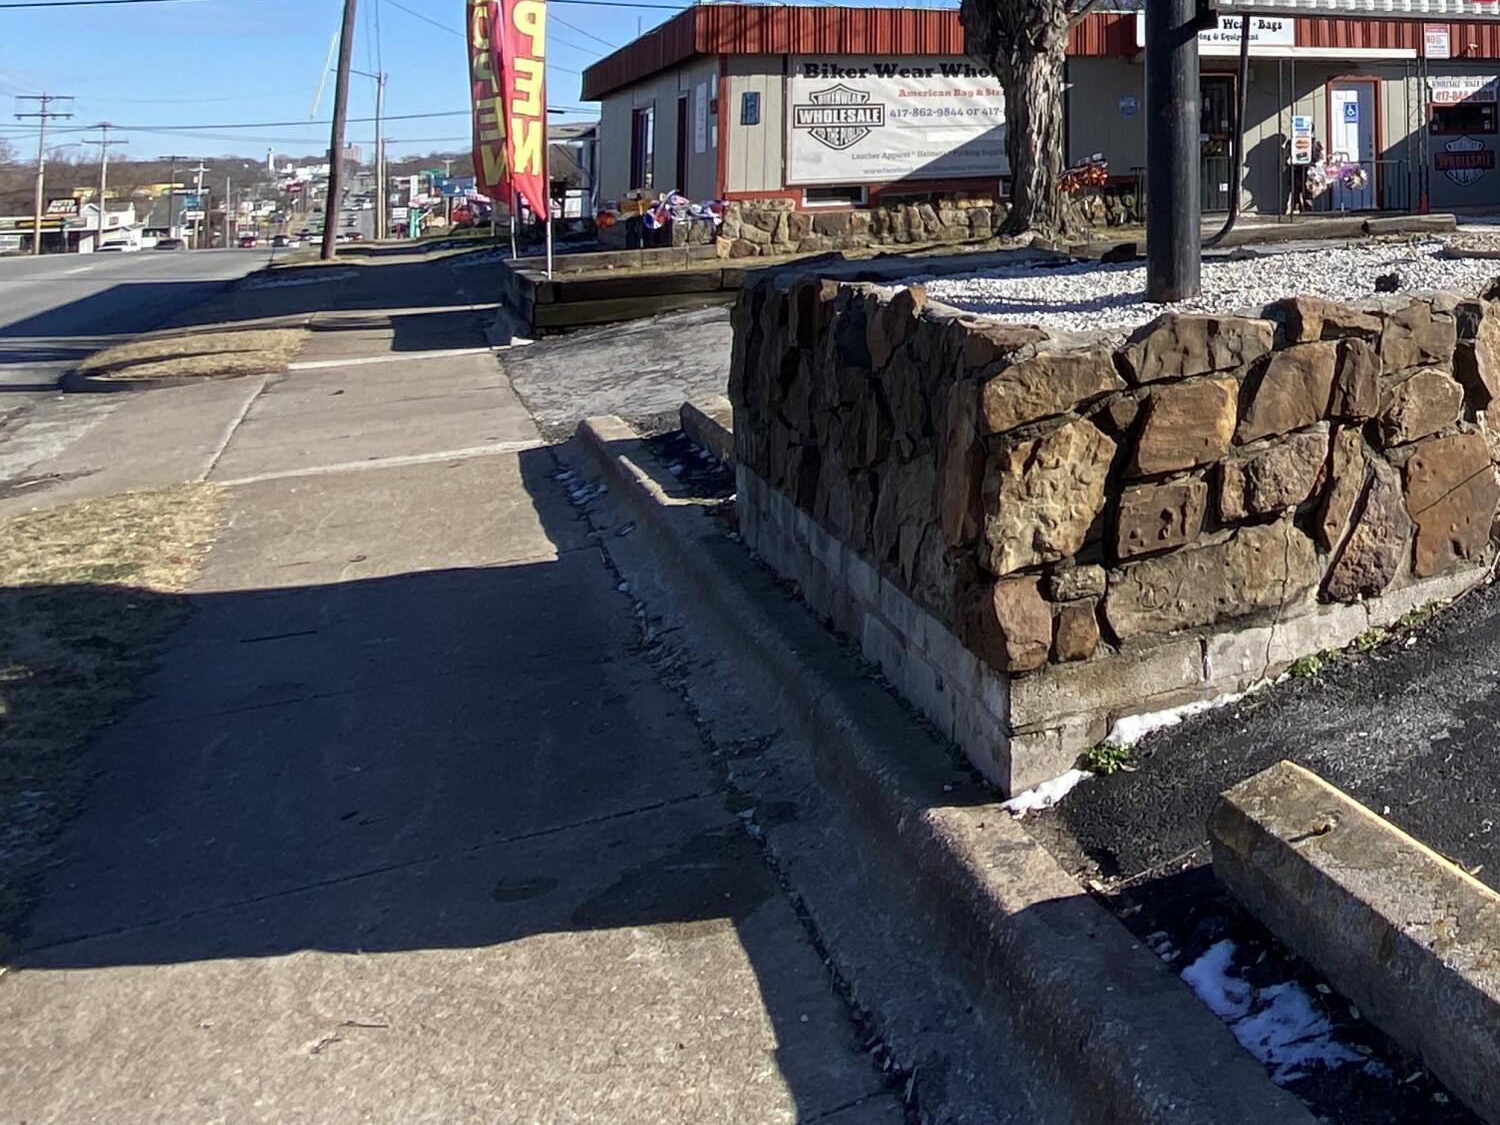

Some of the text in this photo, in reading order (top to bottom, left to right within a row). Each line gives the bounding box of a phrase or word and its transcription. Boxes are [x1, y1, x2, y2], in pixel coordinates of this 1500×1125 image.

[1257, 19, 1283, 32] Bags
[803, 61, 1001, 80] Biker Wear Who
[898, 88, 951, 98] American
[953, 88, 974, 101] Bag
[985, 87, 1004, 98] Str
[799, 108, 881, 124] WHOLESALE
[889, 106, 1004, 119] 417-862-9844 or 417-
